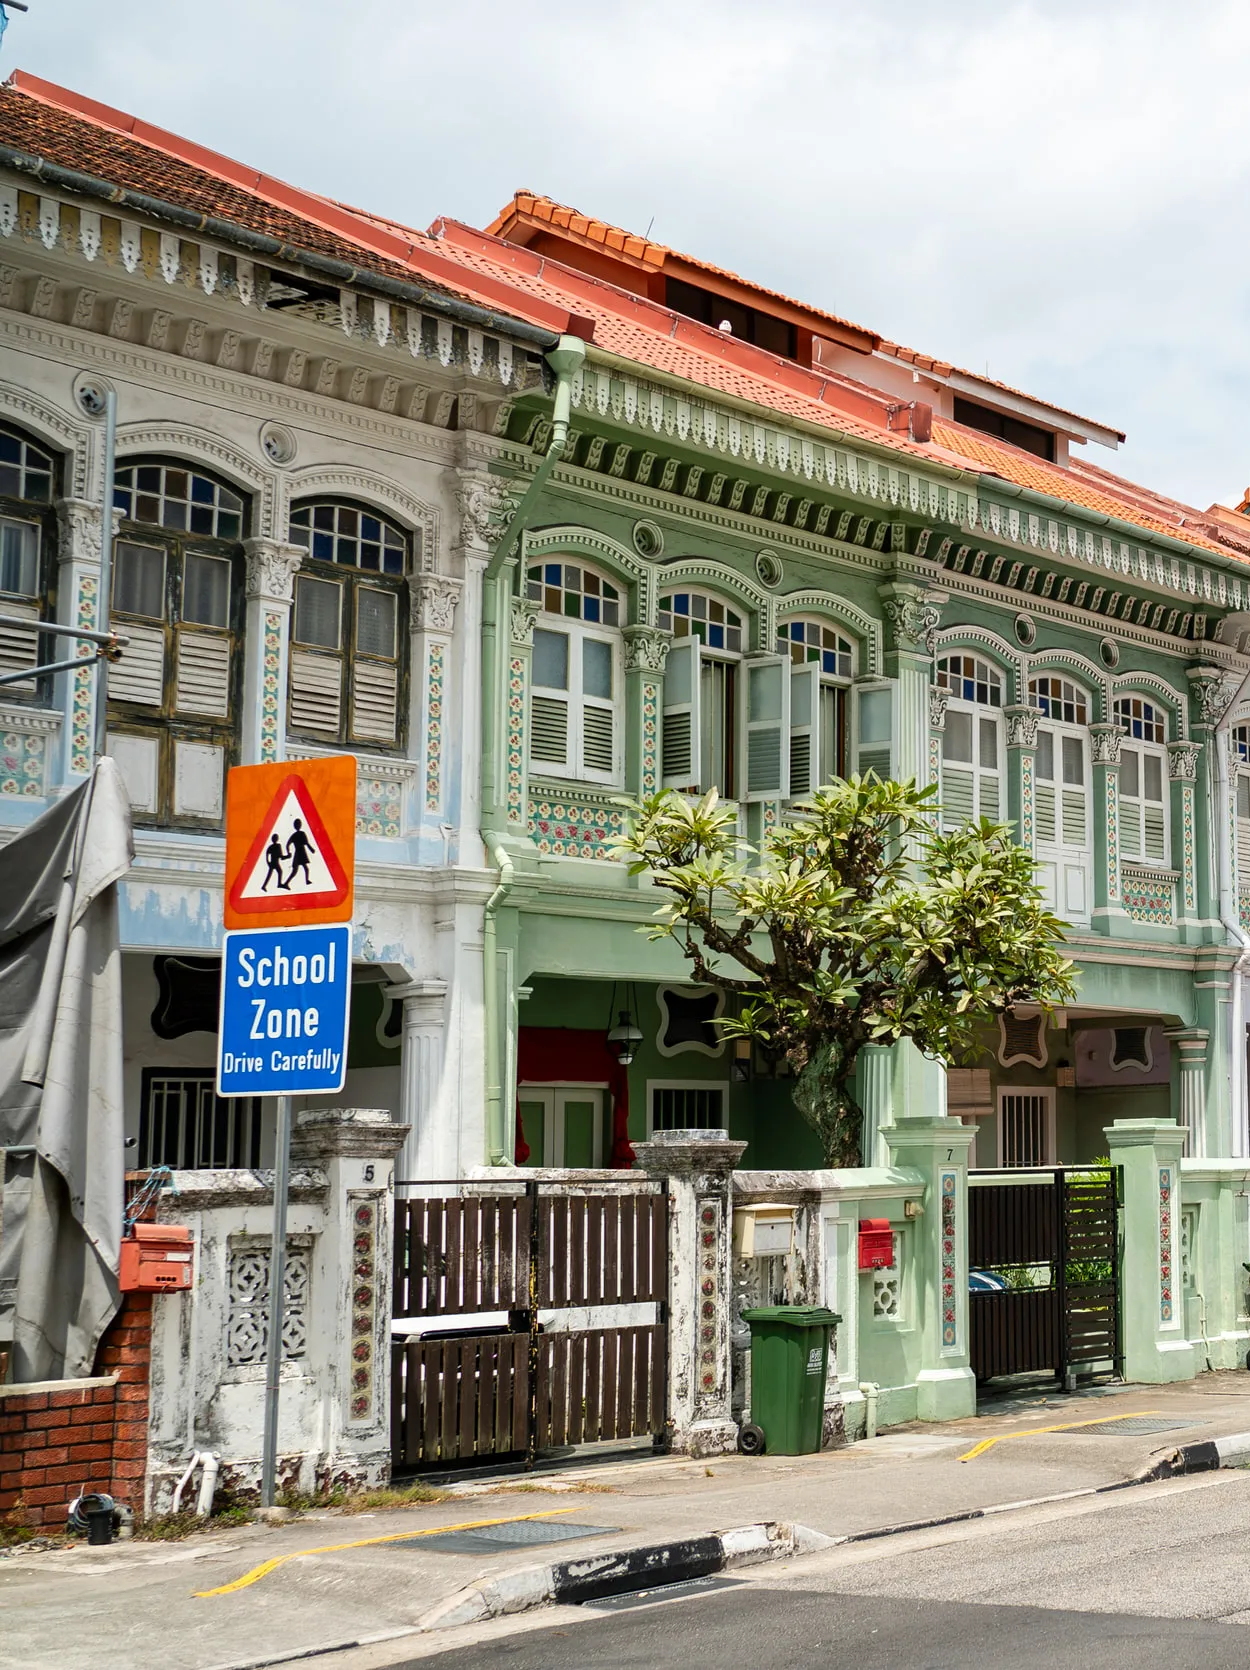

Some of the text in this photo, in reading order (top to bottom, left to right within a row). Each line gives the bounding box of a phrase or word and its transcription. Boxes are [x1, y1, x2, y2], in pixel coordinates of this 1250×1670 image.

[237, 941, 336, 988] School
[249, 998, 319, 1040] Zone
[223, 1048, 341, 1075] Drive Carefully
[946, 1148, 954, 1161] 7
[364, 1164, 375, 1182] 5
